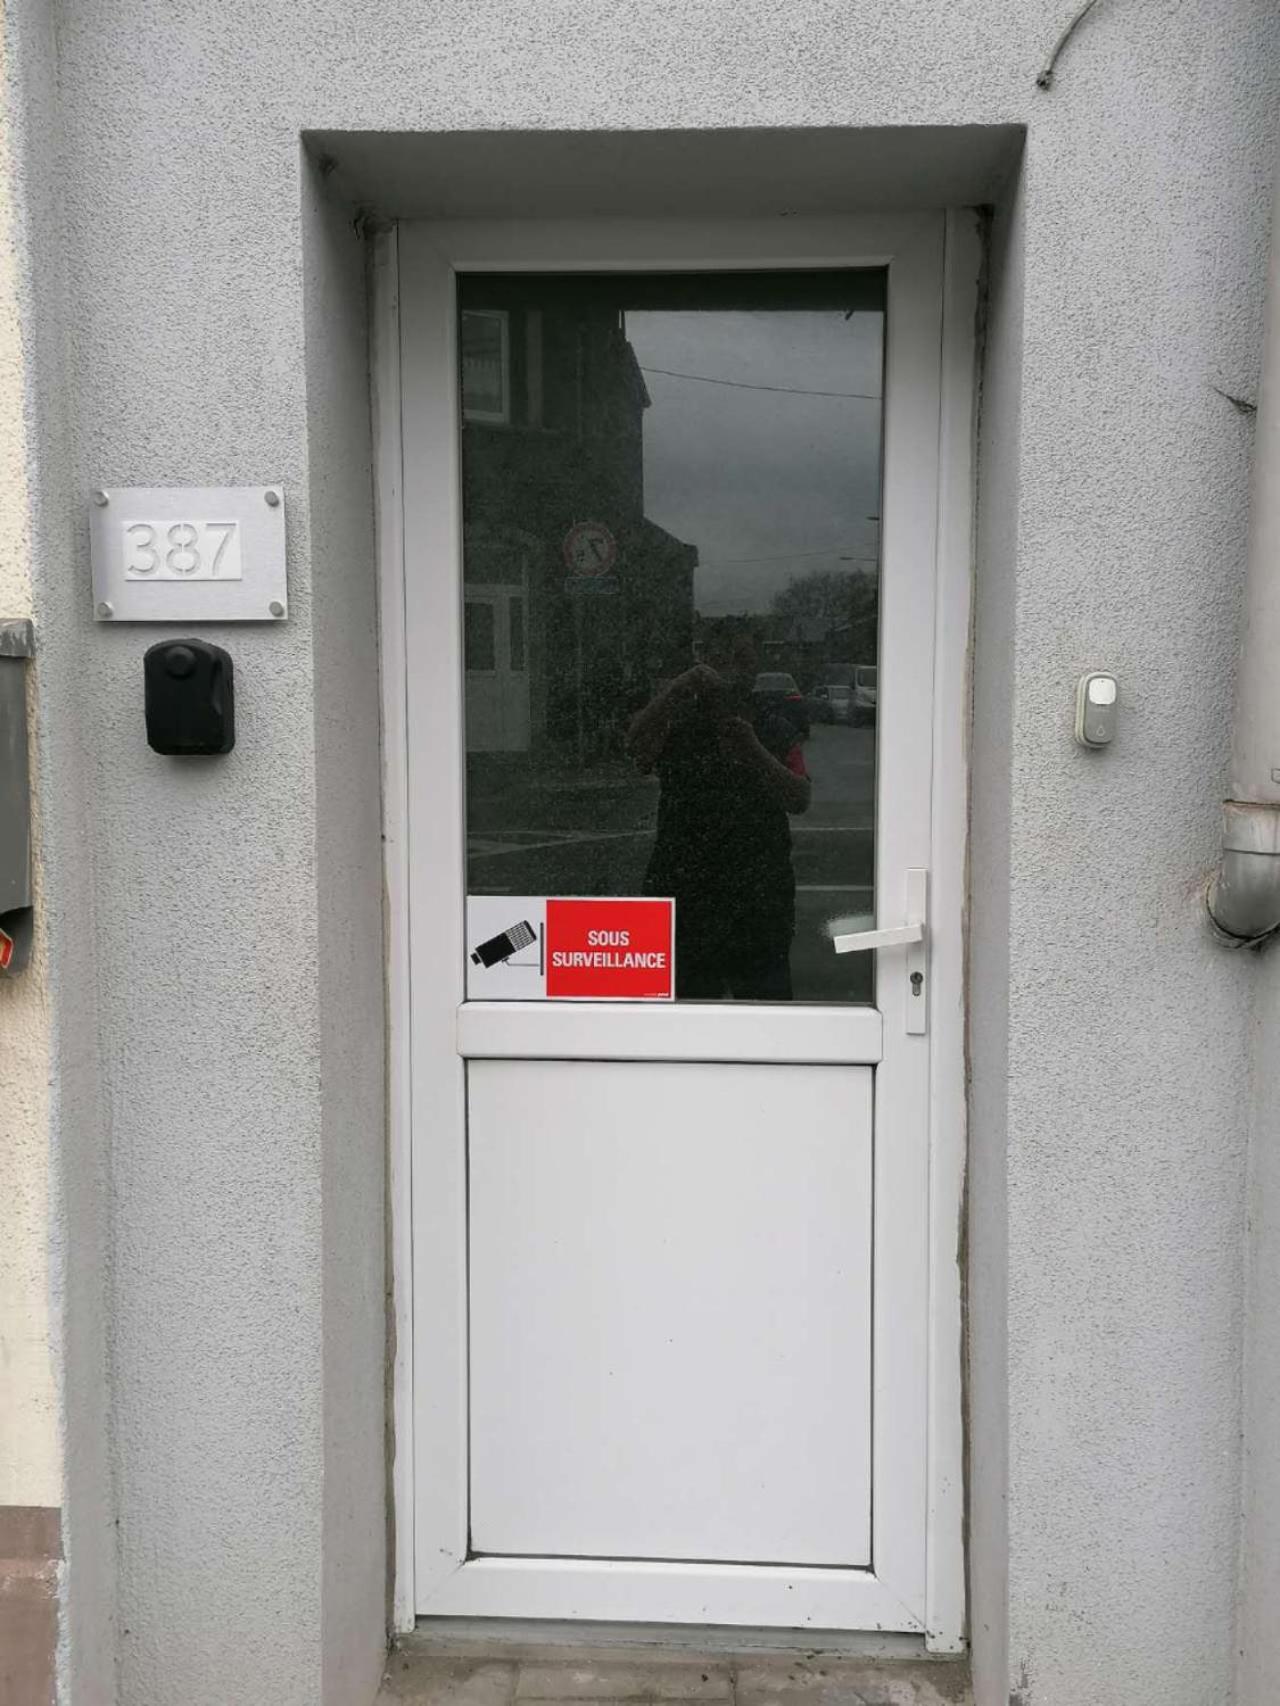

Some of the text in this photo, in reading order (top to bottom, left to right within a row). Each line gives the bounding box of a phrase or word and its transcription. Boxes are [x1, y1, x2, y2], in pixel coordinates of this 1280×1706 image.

[127, 522, 237, 576] 387
[588, 930, 630, 947] SOUS
[552, 952, 666, 969] SURVEILLANCE
